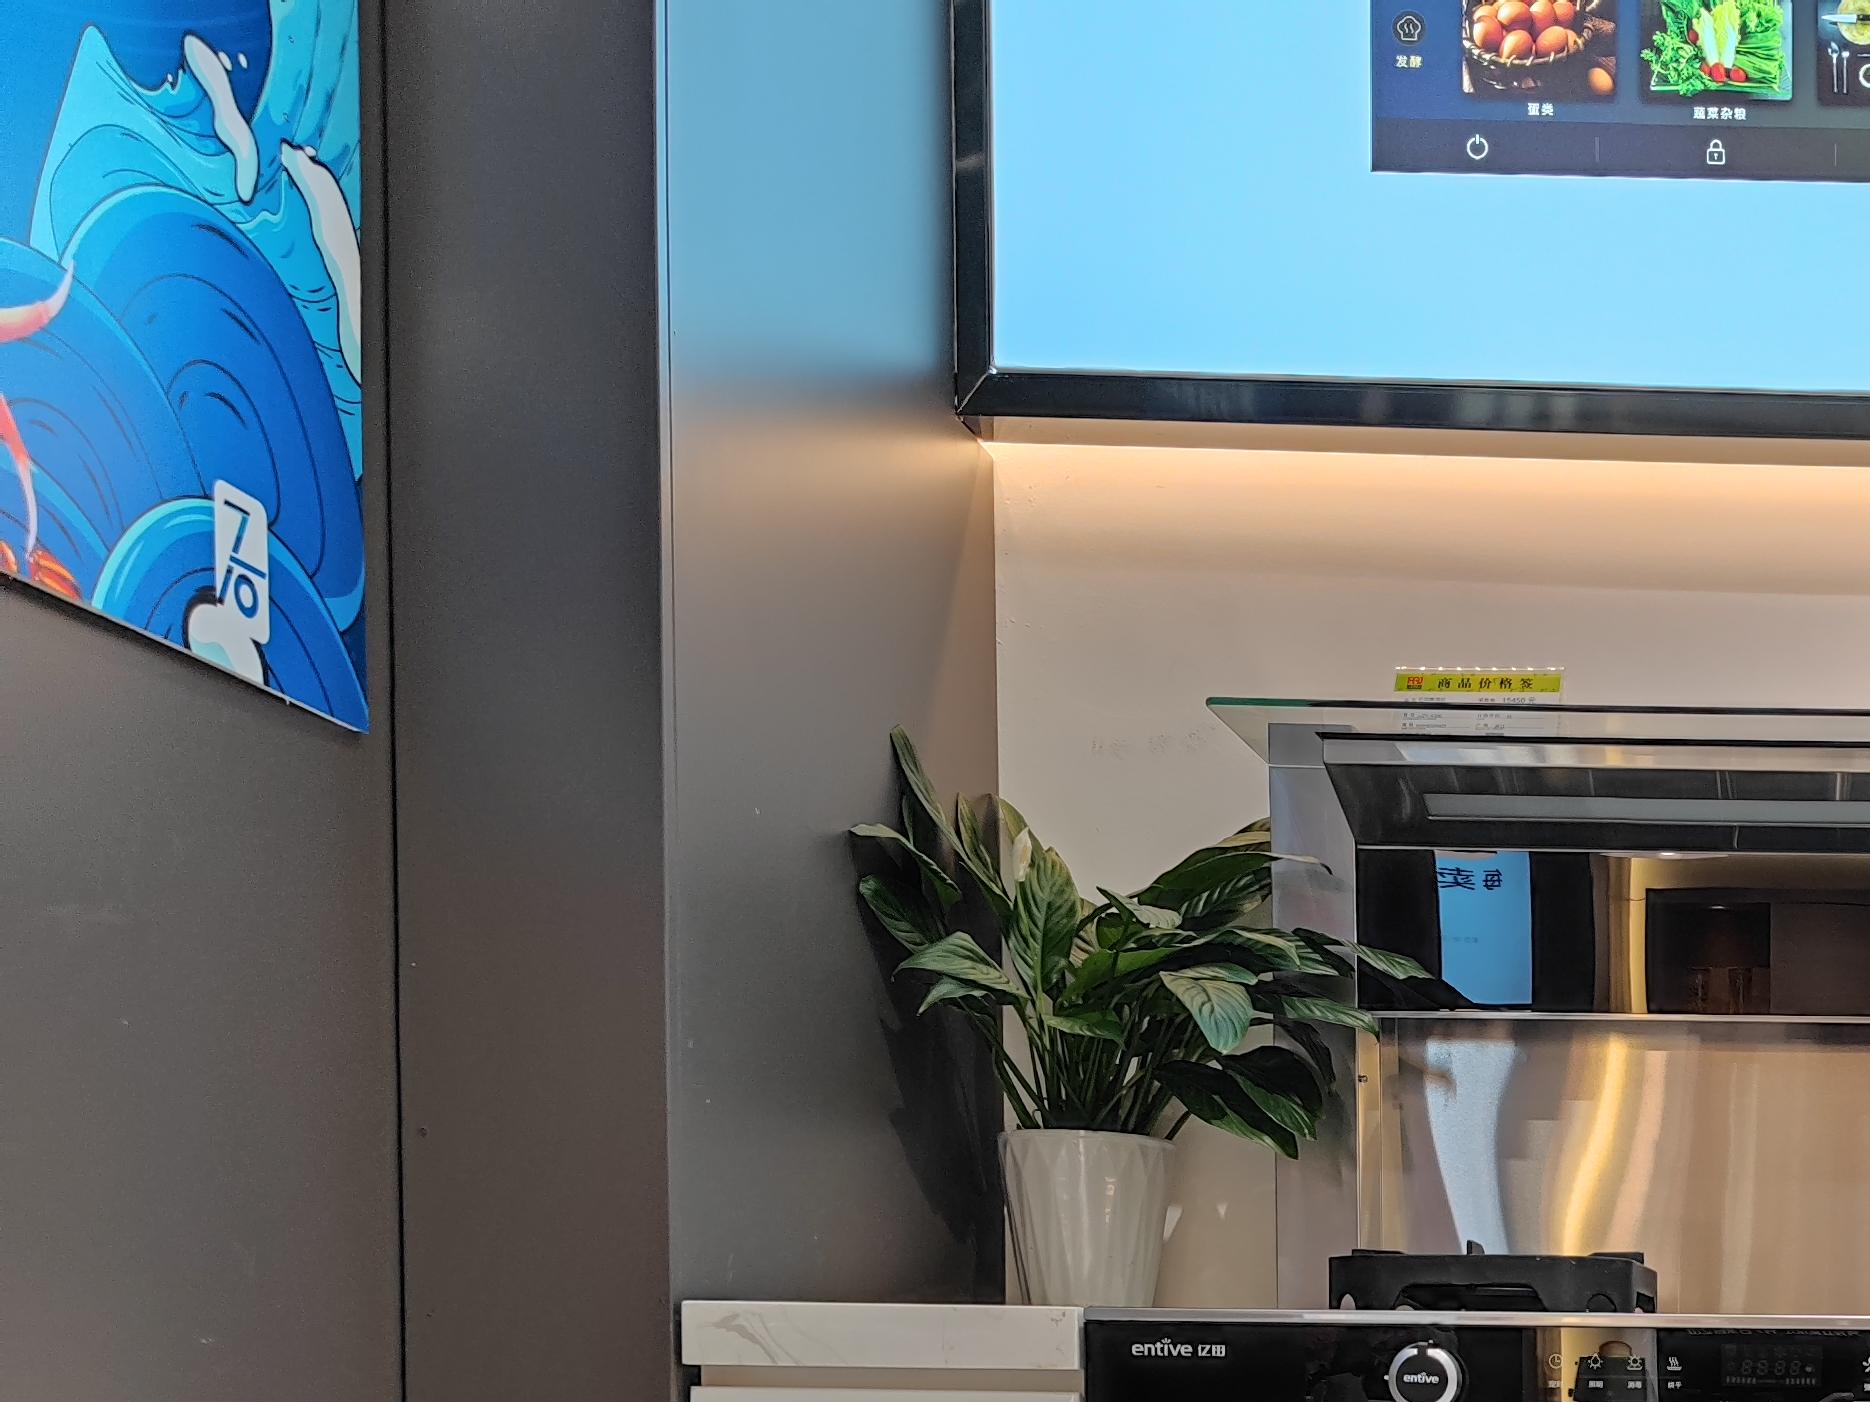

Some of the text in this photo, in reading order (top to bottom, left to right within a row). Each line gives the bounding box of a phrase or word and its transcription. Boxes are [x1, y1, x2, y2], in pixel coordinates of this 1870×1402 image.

[1395, 55, 1423, 69] 发酵
[1527, 103, 1554, 116] 蛋类
[1692, 106, 1748, 121] 蔬菜杂粮
[1437, 677, 1534, 689] 商品价格签
[1131, 1338, 1193, 1357] entive
[1403, 1372, 1440, 1384] entive
